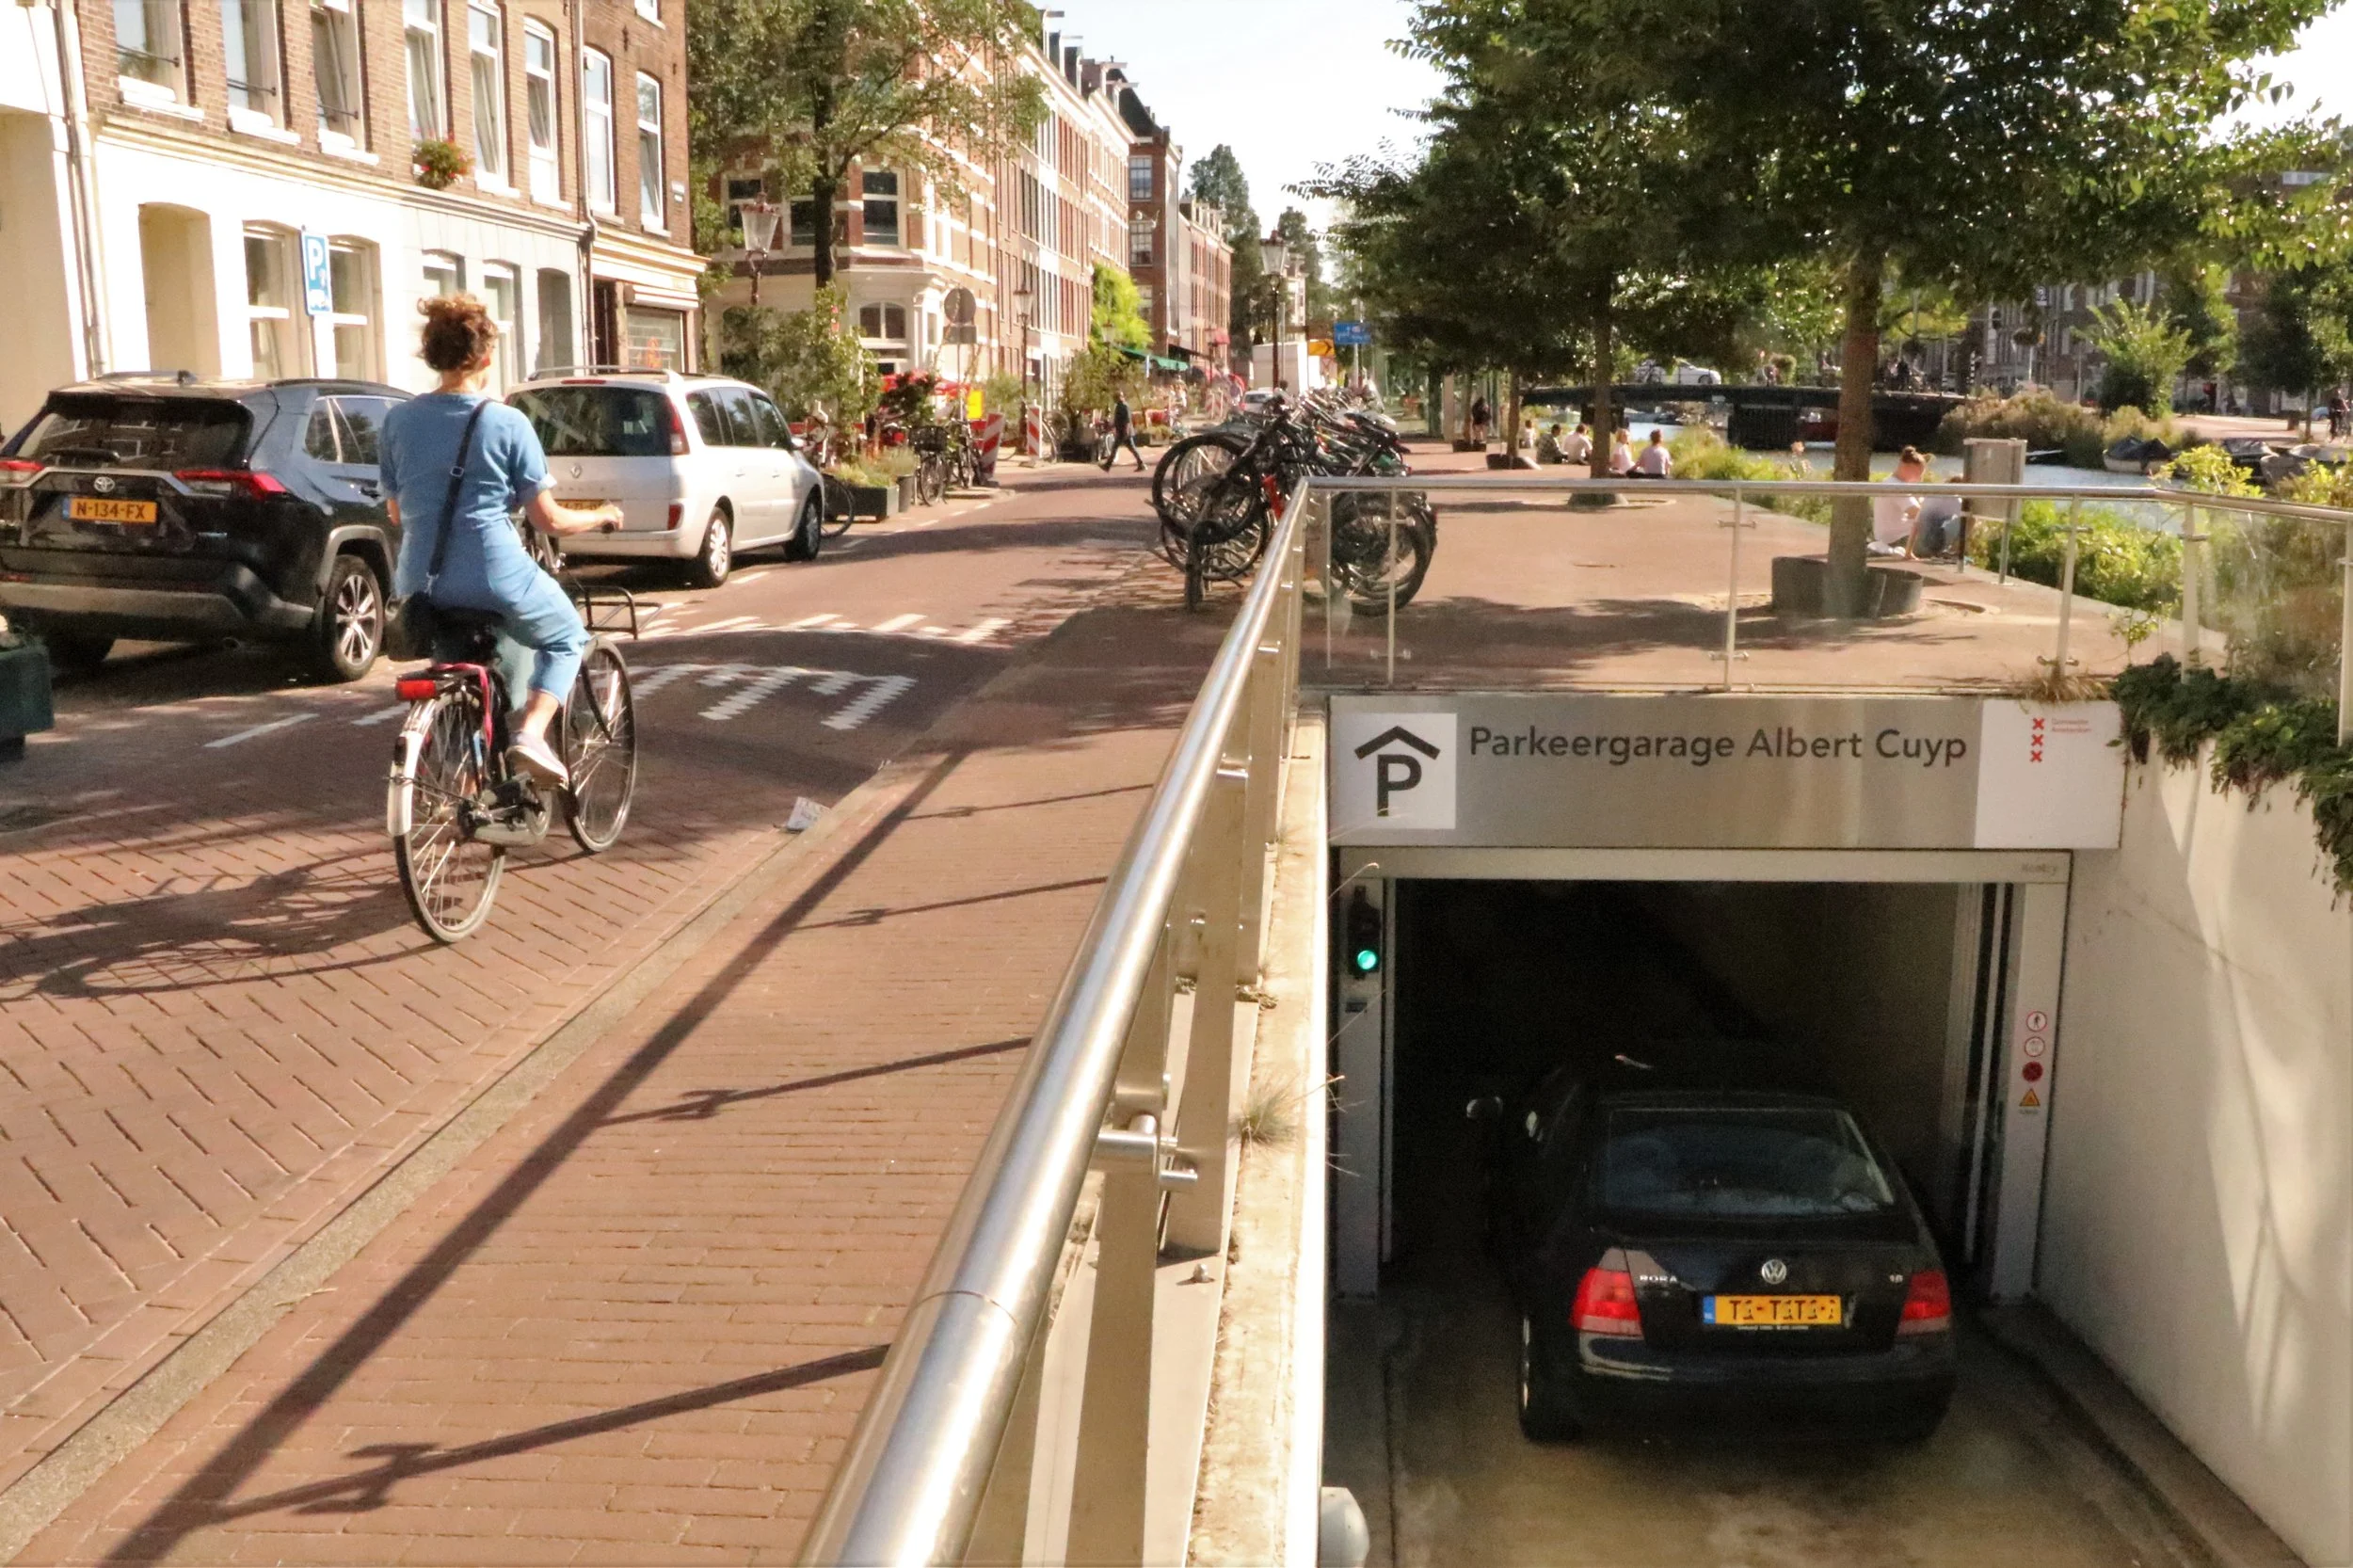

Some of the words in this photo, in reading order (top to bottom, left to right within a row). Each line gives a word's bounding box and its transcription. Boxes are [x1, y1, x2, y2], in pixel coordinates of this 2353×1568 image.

[308, 238, 324, 280] P
[76, 502, 145, 519] N-134-FX
[1471, 726, 1735, 766] Parkeergarage
[1746, 728, 1863, 759] Albert
[1876, 728, 1967, 767] Cuyp
[1377, 754, 1423, 817] P
